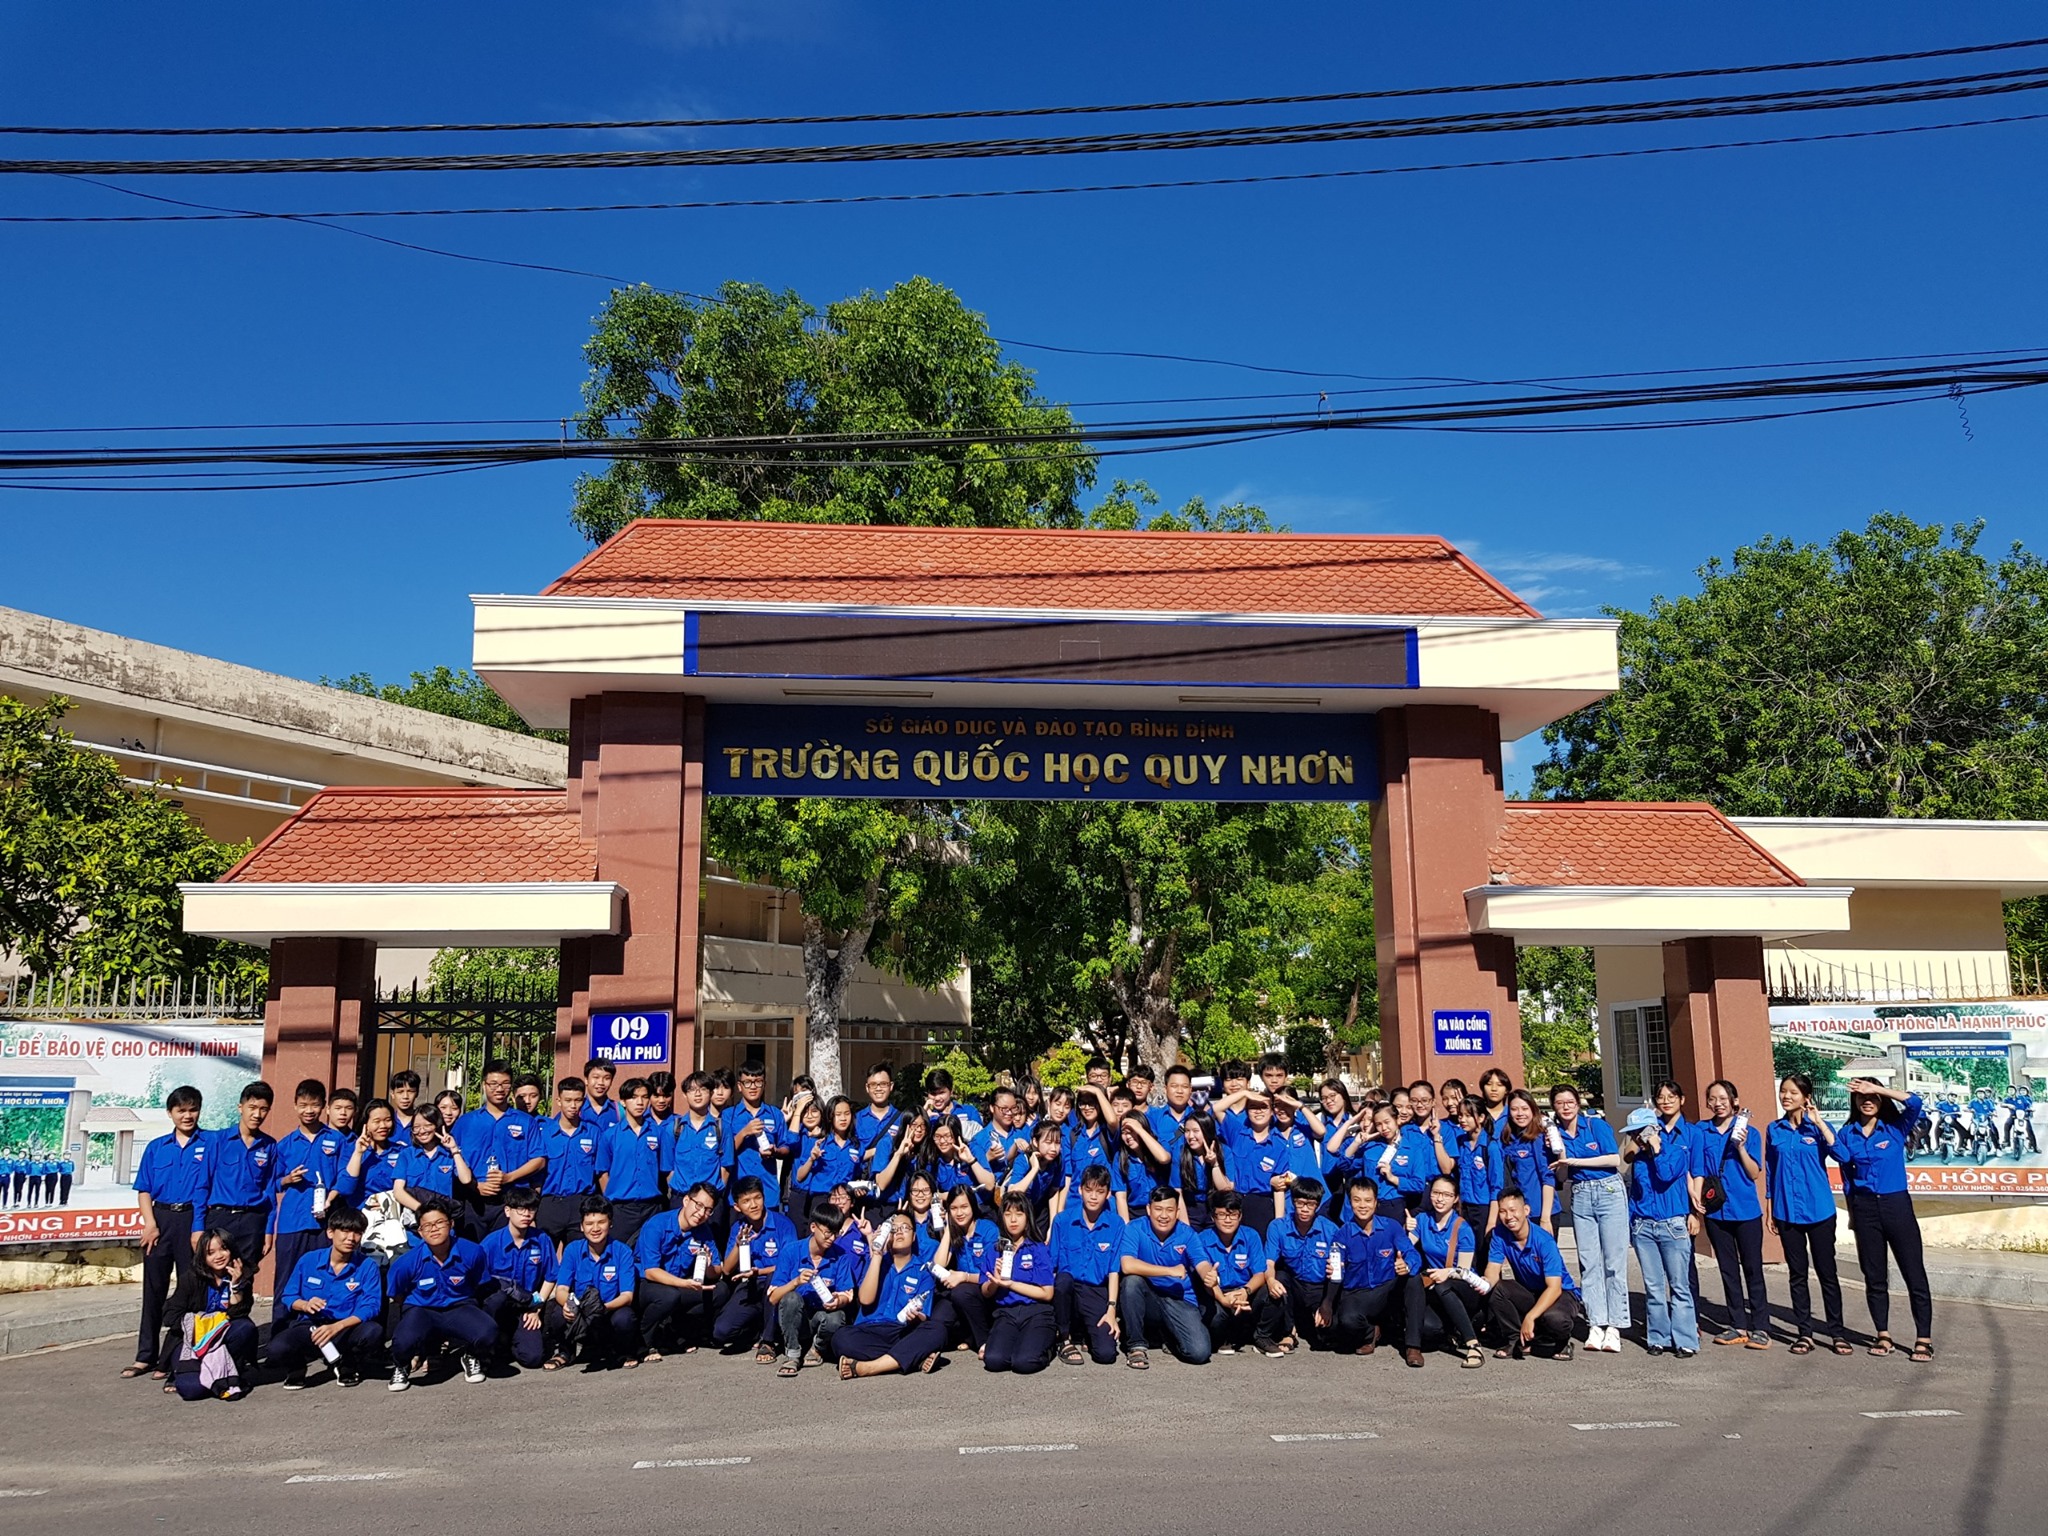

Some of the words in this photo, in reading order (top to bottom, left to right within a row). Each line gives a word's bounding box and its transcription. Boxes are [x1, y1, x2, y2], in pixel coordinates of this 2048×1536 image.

[901, 716, 948, 735] GIÁO
[955, 720, 996, 739] DỤC
[1002, 716, 1026, 735] VÀ
[1035, 717, 1076, 736] ĐÀO
[1083, 721, 1122, 740] TẠO
[1130, 718, 1179, 737] BÌNH
[1186, 721, 1234, 743] ĐỊNH
[723, 738, 900, 780] TRƯỜNG
[913, 739, 1030, 786] QUỐC
[1044, 752, 1129, 792] HỌC
[1144, 754, 1227, 789] QUY
[1242, 750, 1355, 785] NHƠN
[611, 1016, 649, 1040] 09
[1438, 1019, 1449, 1031] RA
[1449, 1016, 1465, 1031] VÀO
[1789, 1020, 1807, 1033] AN
[1811, 1017, 1848, 1033] TOÀN
[1851, 1019, 1884, 1032] GIAO
[1887, 1015, 1935, 1031] THÔNG
[1940, 1014, 1957, 1030] LÀ
[1962, 1016, 2002, 1031] HẠNH
[2007, 1012, 2047, 1029] PHÚC
[19, 1032, 43, 1056] ĐỂ
[47, 1034, 80, 1056] BẢO
[86, 1037, 106, 1060] VỆ
[112, 1041, 143, 1057] CHO
[148, 1038, 195, 1057] CHÍNH
[200, 1038, 238, 1057] MÌNH
[597, 1042, 631, 1061] TRẦN
[635, 1043, 662, 1060] PHÚ
[1445, 1034, 1471, 1051] XUỐNG
[1472, 1038, 1483, 1051] XE
[4, 1098, 22, 1106] HỌC
[24, 1098, 41, 1106] QUY
[1941, 1167, 2018, 1184] HỒNG
[75, 1211, 146, 1229] PHƯ
